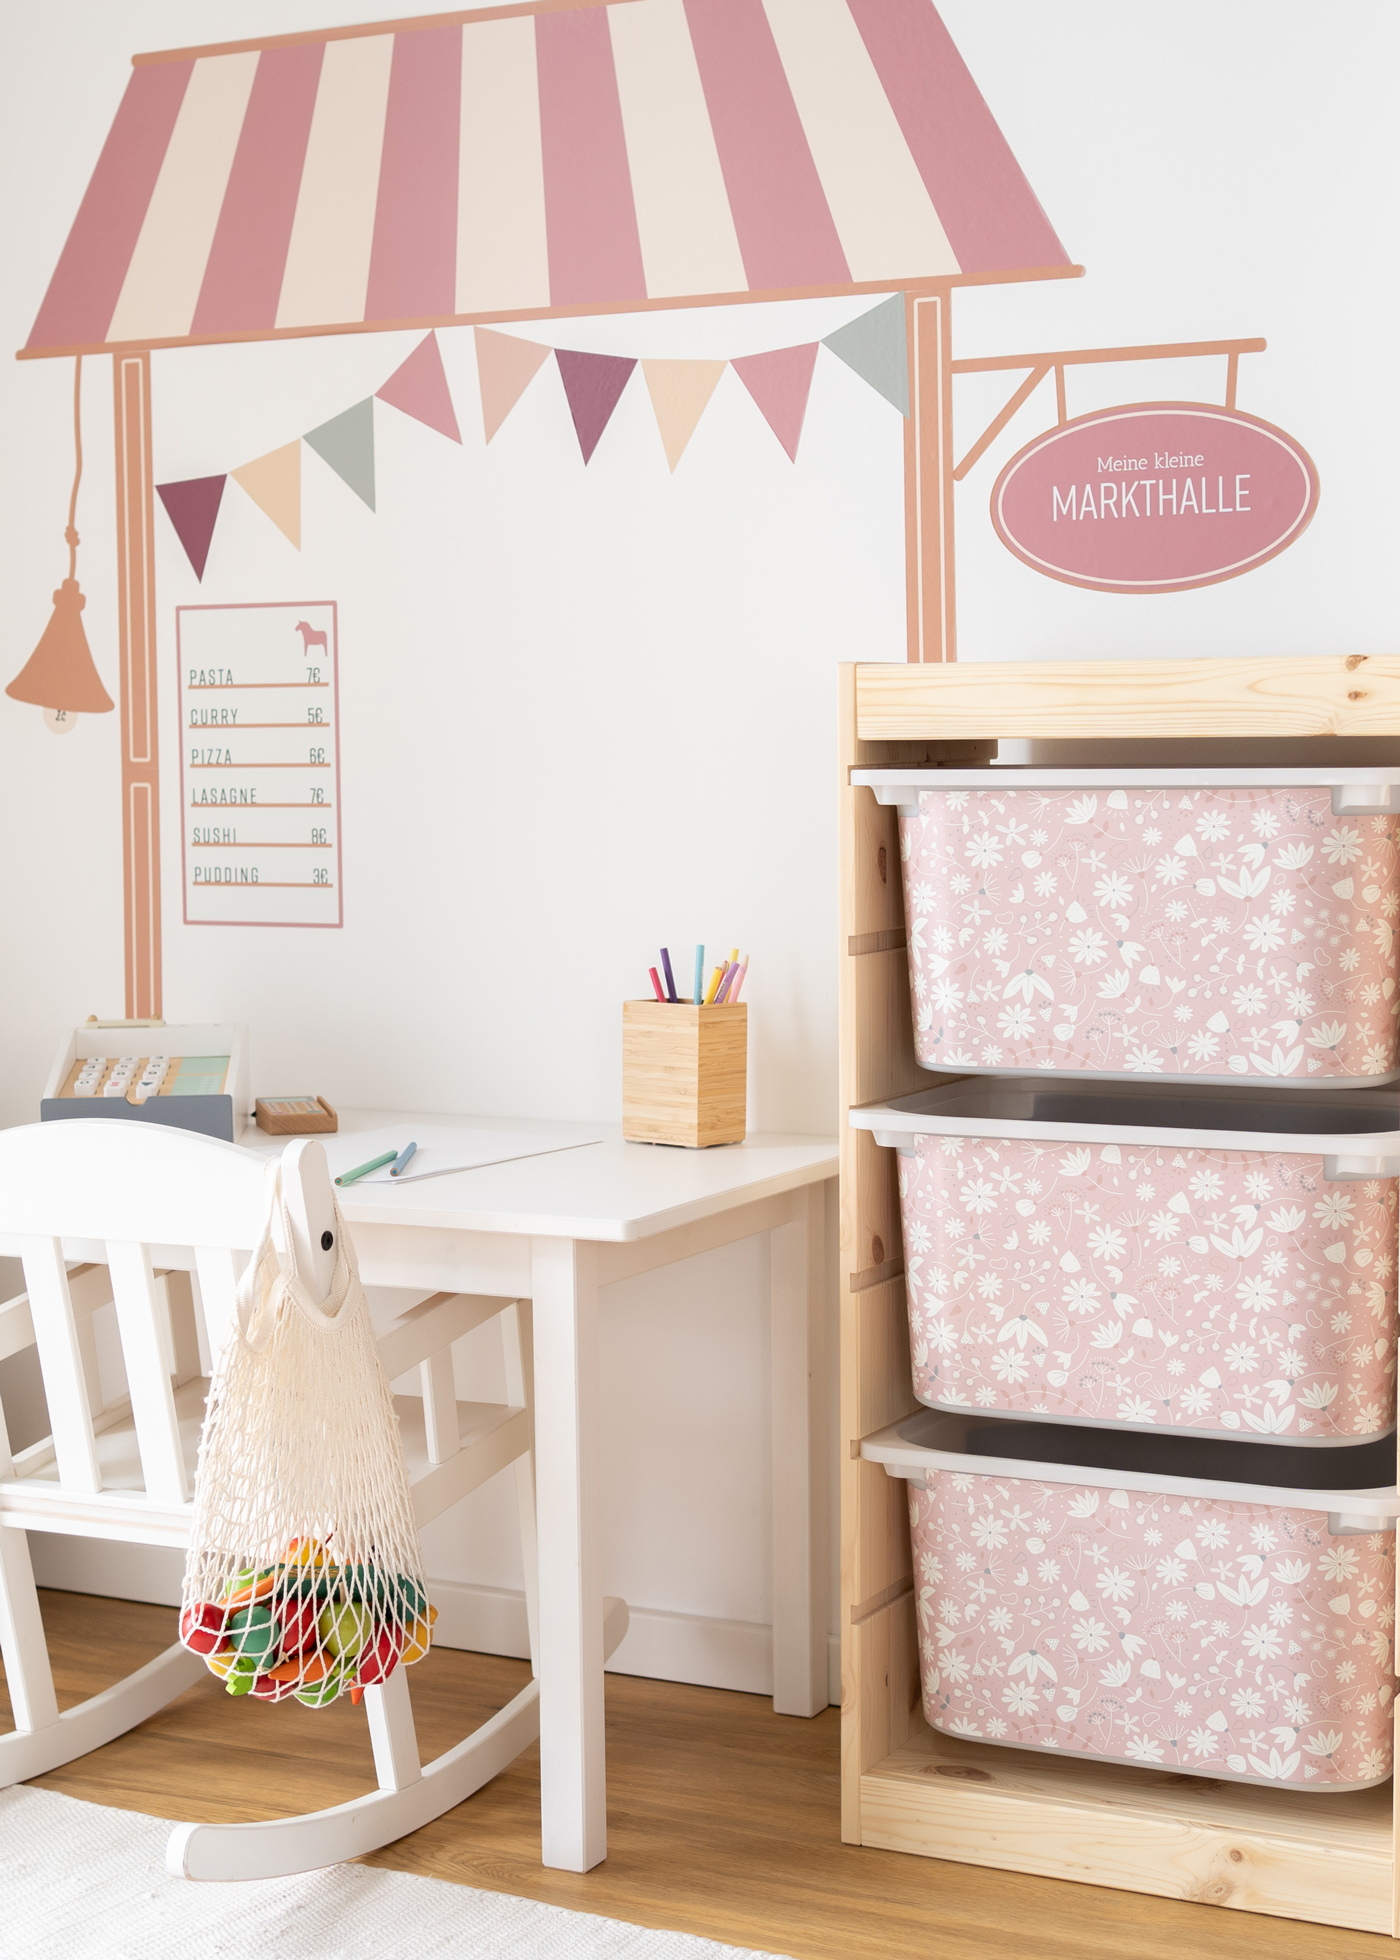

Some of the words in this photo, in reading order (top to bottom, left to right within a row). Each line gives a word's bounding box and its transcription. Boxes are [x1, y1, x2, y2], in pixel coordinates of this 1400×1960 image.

[1096, 455, 1148, 473] Meine
[1154, 451, 1205, 470] kleine
[1052, 473, 1251, 522] MARKTHALLE
[189, 669, 234, 685] PASTA
[306, 667, 321, 683] 7€
[190, 708, 238, 724] CURRY
[308, 707, 323, 723] 5€
[191, 748, 232, 764] PIZZA
[310, 747, 325, 763] 6€
[192, 788, 258, 804] LASAGNE
[310, 787, 325, 804] 7€
[193, 827, 237, 844] SUSHI
[312, 828, 327, 844] 8€
[194, 866, 259, 883] PUDDING
[313, 868, 329, 884] 3€
